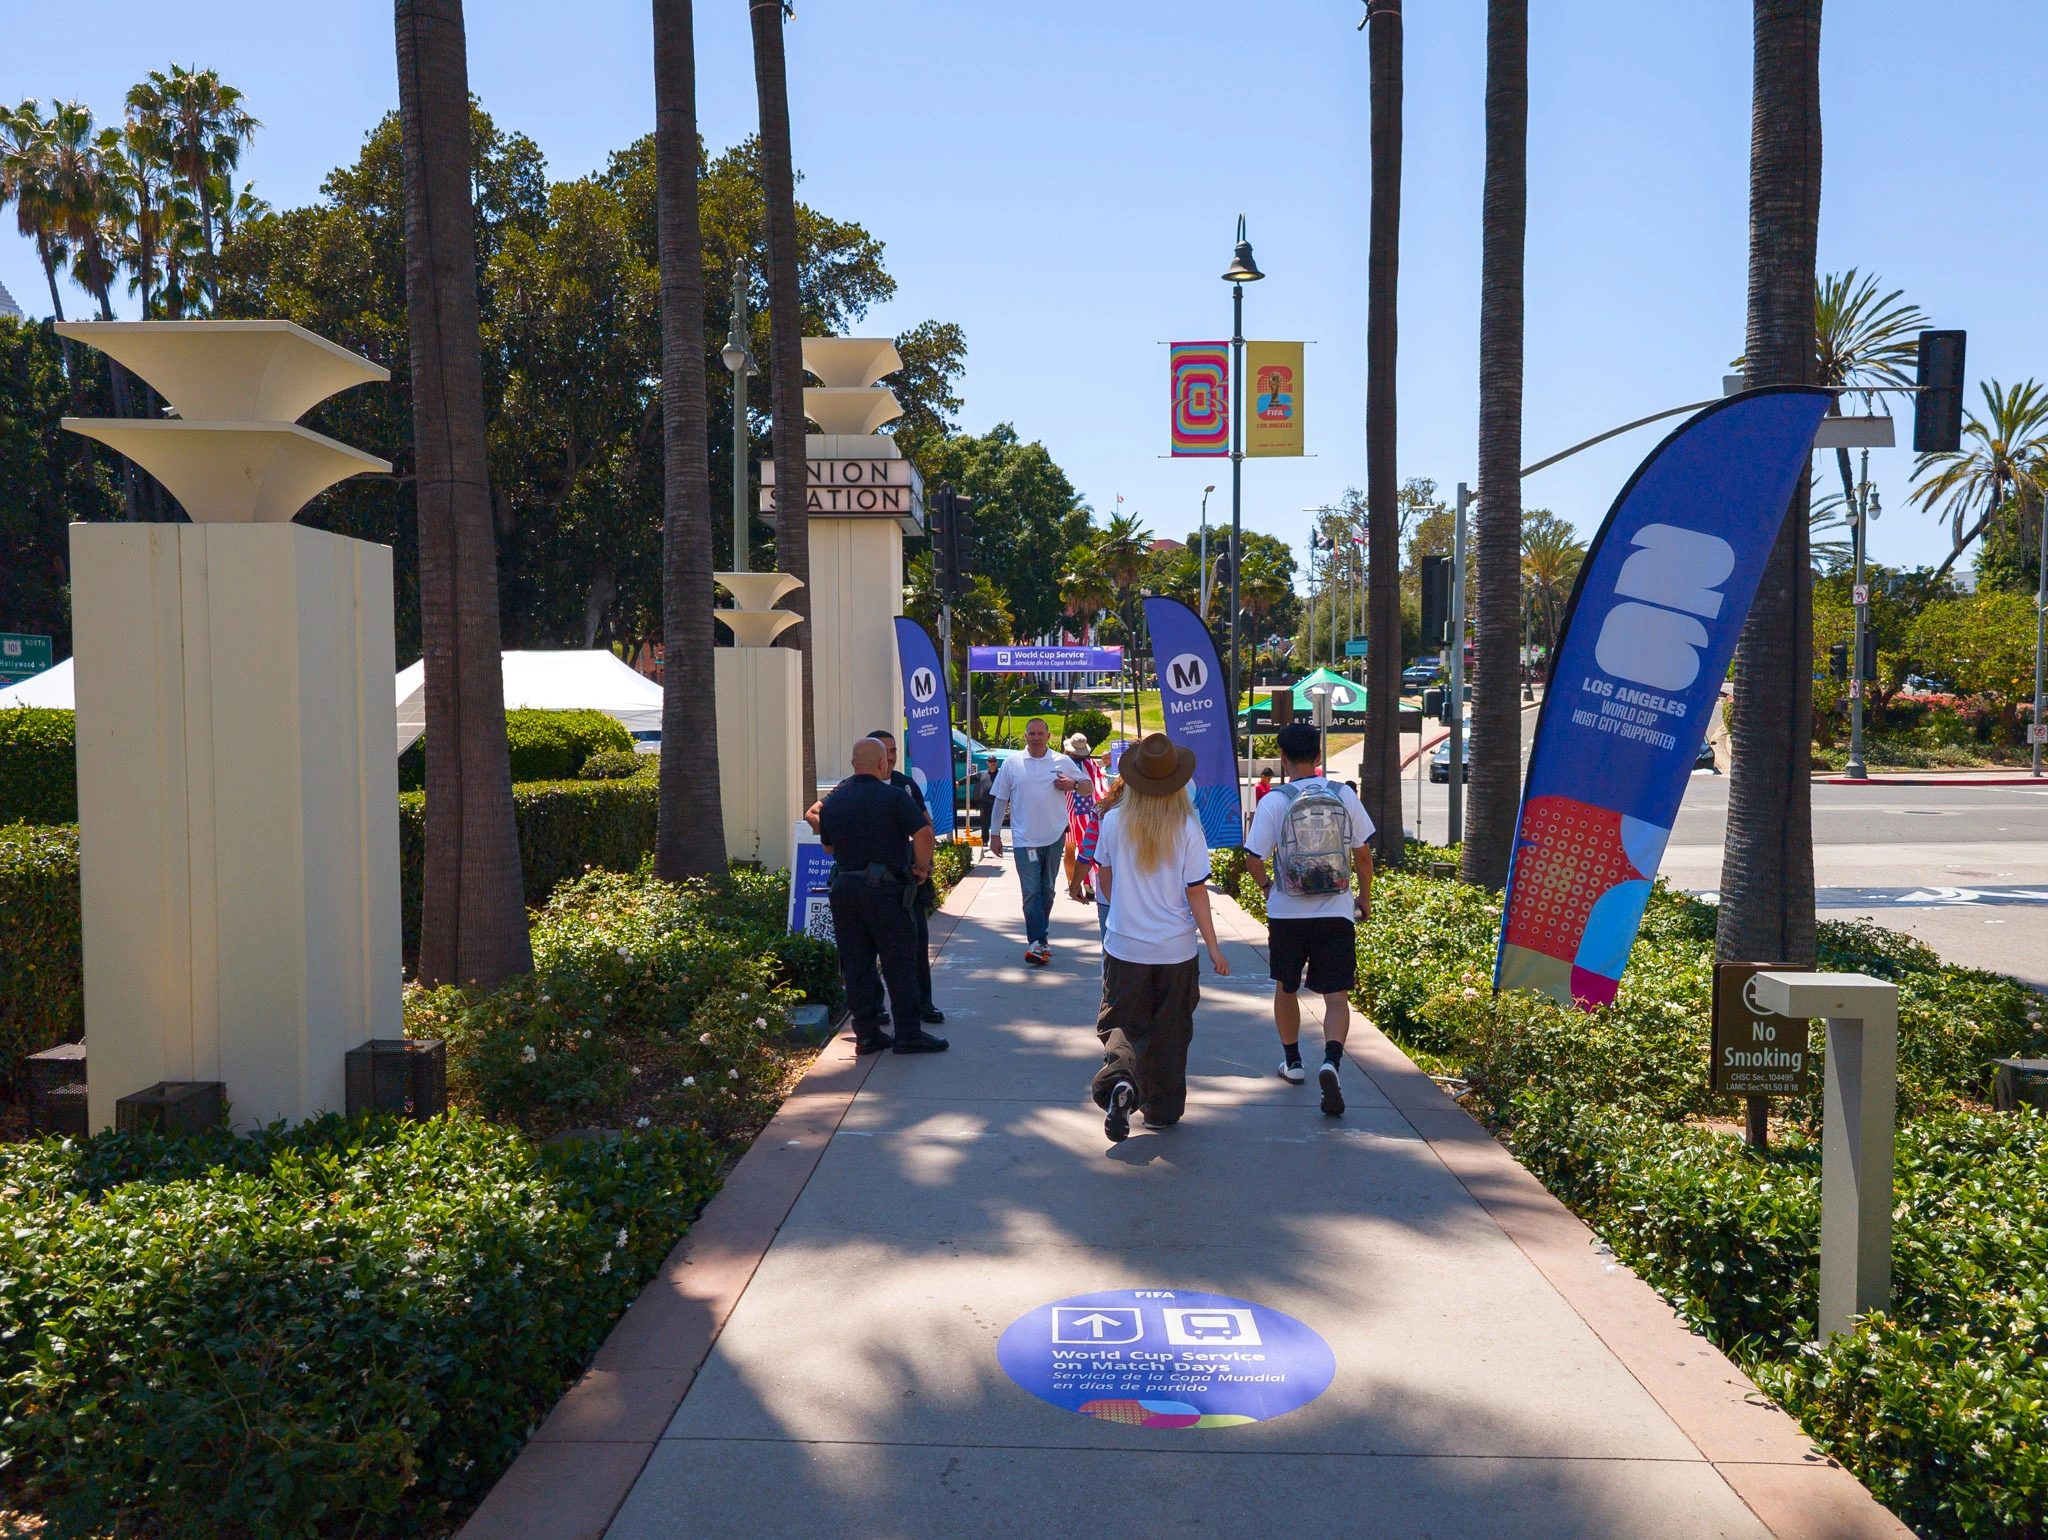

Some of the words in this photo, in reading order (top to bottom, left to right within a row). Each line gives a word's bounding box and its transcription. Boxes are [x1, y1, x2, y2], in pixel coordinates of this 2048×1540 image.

[806, 462, 888, 483] NION
[769, 489, 899, 510] SATION
[8, 643, 18, 652] 101
[24, 639, 46, 647] NORTH
[1014, 651, 1038, 659] World
[1039, 651, 1054, 660] Cup
[1055, 651, 1085, 659] Service
[0, 660, 35, 669] Hollywood
[1173, 660, 1201, 689] M
[914, 673, 932, 697] M
[1582, 677, 1614, 697] LOS
[1614, 686, 1687, 718] ANGELES
[912, 705, 940, 719] Metro
[1170, 698, 1213, 714] Metro
[1601, 700, 1637, 722] WORLD
[1636, 709, 1658, 727] CUP
[1572, 709, 1600, 728] HOST
[1598, 716, 1622, 734] CITY
[1620, 723, 1676, 751] SUPPORTER
[1752, 1021, 1776, 1041] No
[1724, 1047, 1802, 1073] Smoking
[1731, 1073, 1751, 1081] CHSC
[1752, 1073, 1767, 1081] Sec.
[1768, 1073, 1794, 1081] 104495
[1726, 1083, 1746, 1091] LAMC
[1791, 1083, 1799, 1092] 18
[1052, 1350, 1120, 1360] World
[1129, 1351, 1174, 1363] Cup
[1182, 1351, 1266, 1362] Service
[1052, 1362, 1082, 1370] on
[1092, 1361, 1165, 1371] Match
[1174, 1362, 1231, 1374] Days
[1052, 1371, 1116, 1380] Servicio
[1122, 1372, 1142, 1381] de
[1147, 1372, 1163, 1381] la
[1169, 1373, 1211, 1384] Copa
[1217, 1373, 1286, 1383] Mundial
[1052, 1382, 1073, 1390] en
[1079, 1381, 1114, 1390] días
[1120, 1382, 1140, 1391] de
[1146, 1382, 1208, 1393] partido
